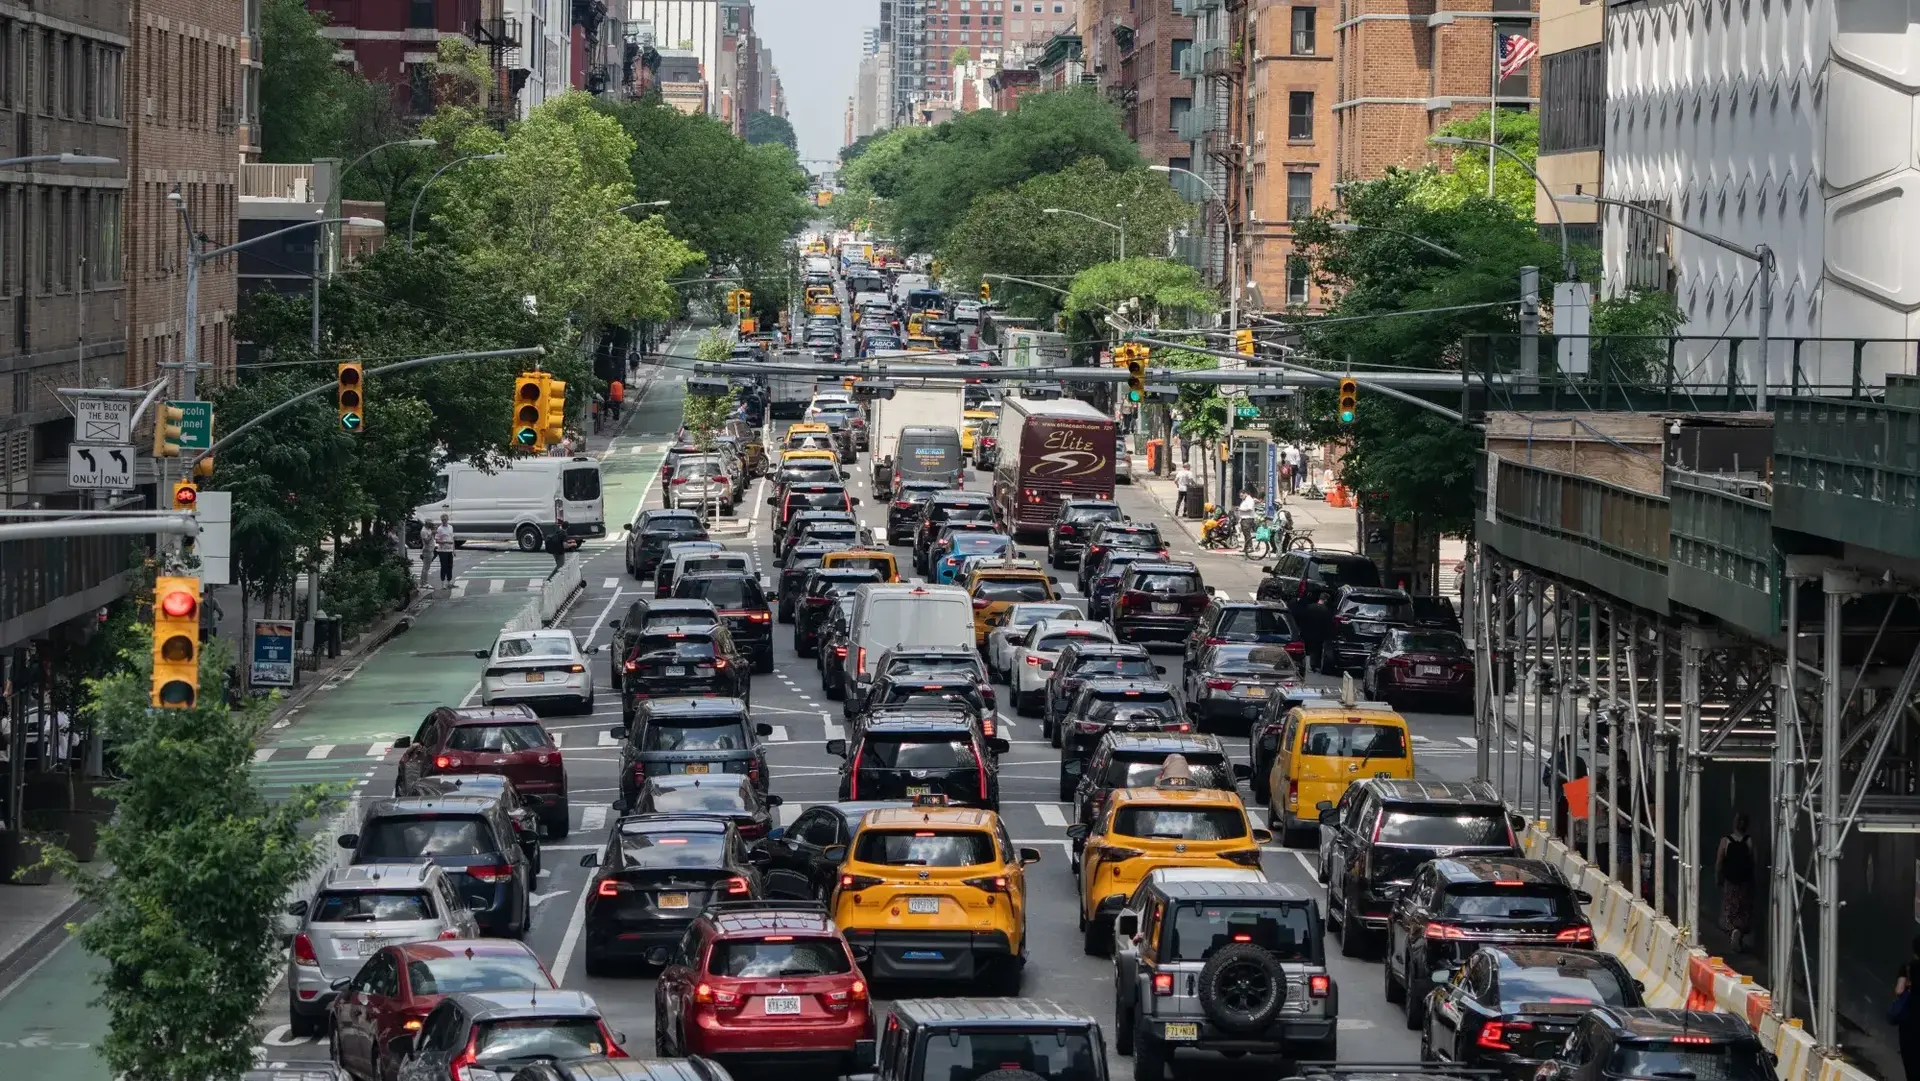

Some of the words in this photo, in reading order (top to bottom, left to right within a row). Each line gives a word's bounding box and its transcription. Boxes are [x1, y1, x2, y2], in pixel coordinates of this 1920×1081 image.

[80, 402, 101, 411] DON'T
[103, 402, 127, 412] BLOCK
[89, 412, 102, 420] THE
[1243, 408, 1250, 416] 42
[1044, 430, 1094, 451] Elite
[73, 475, 98, 484] ONLY
[105, 476, 130, 485] ONLY
